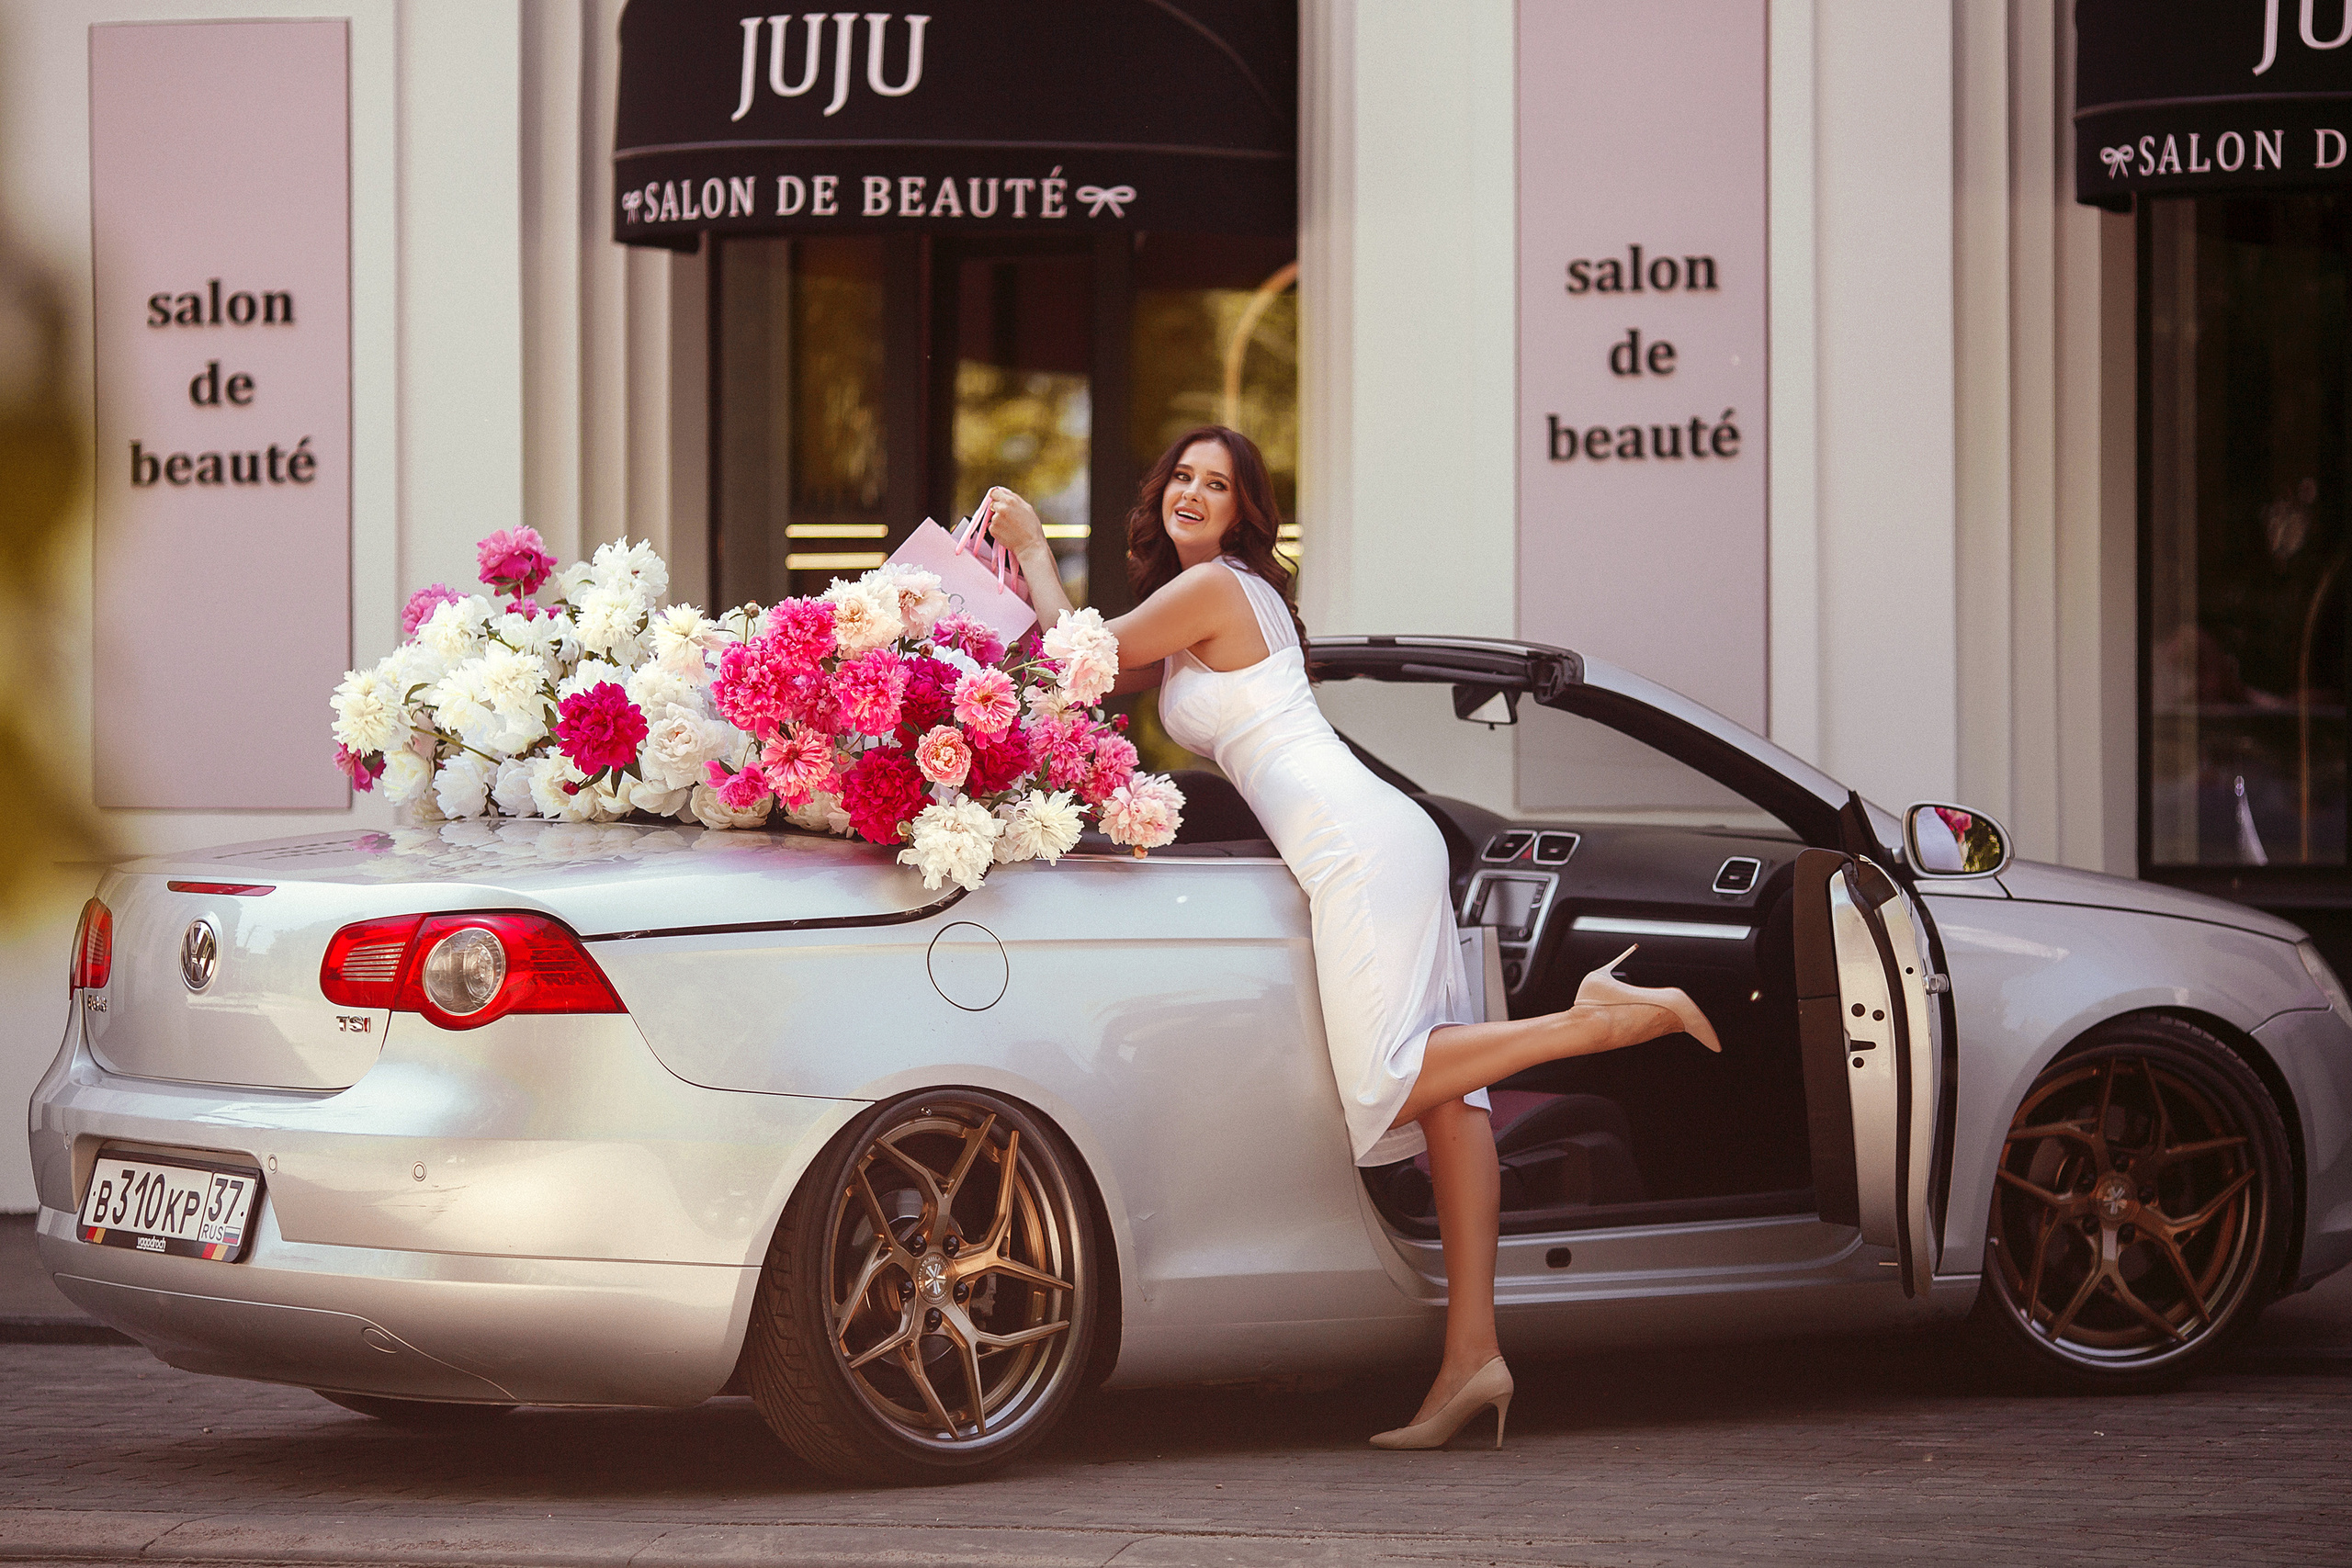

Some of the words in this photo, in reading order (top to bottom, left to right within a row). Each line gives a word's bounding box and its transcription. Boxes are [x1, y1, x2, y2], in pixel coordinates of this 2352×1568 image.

[731, 13, 932, 121] JUJU
[2139, 129, 2284, 176] SALON
[644, 175, 756, 223] SALON
[775, 175, 839, 217] DE
[862, 165, 1069, 219] BEAUTÉ
[1566, 243, 1719, 295] salon
[147, 278, 294, 328] salon
[1609, 328, 1677, 377] de
[189, 360, 255, 407] de
[1547, 408, 1741, 462] beauté
[130, 435, 316, 488] beauté
[335, 1015, 371, 1033] TSI
[208, 1178, 244, 1224] 37
[200, 1224, 224, 1241] RUS
